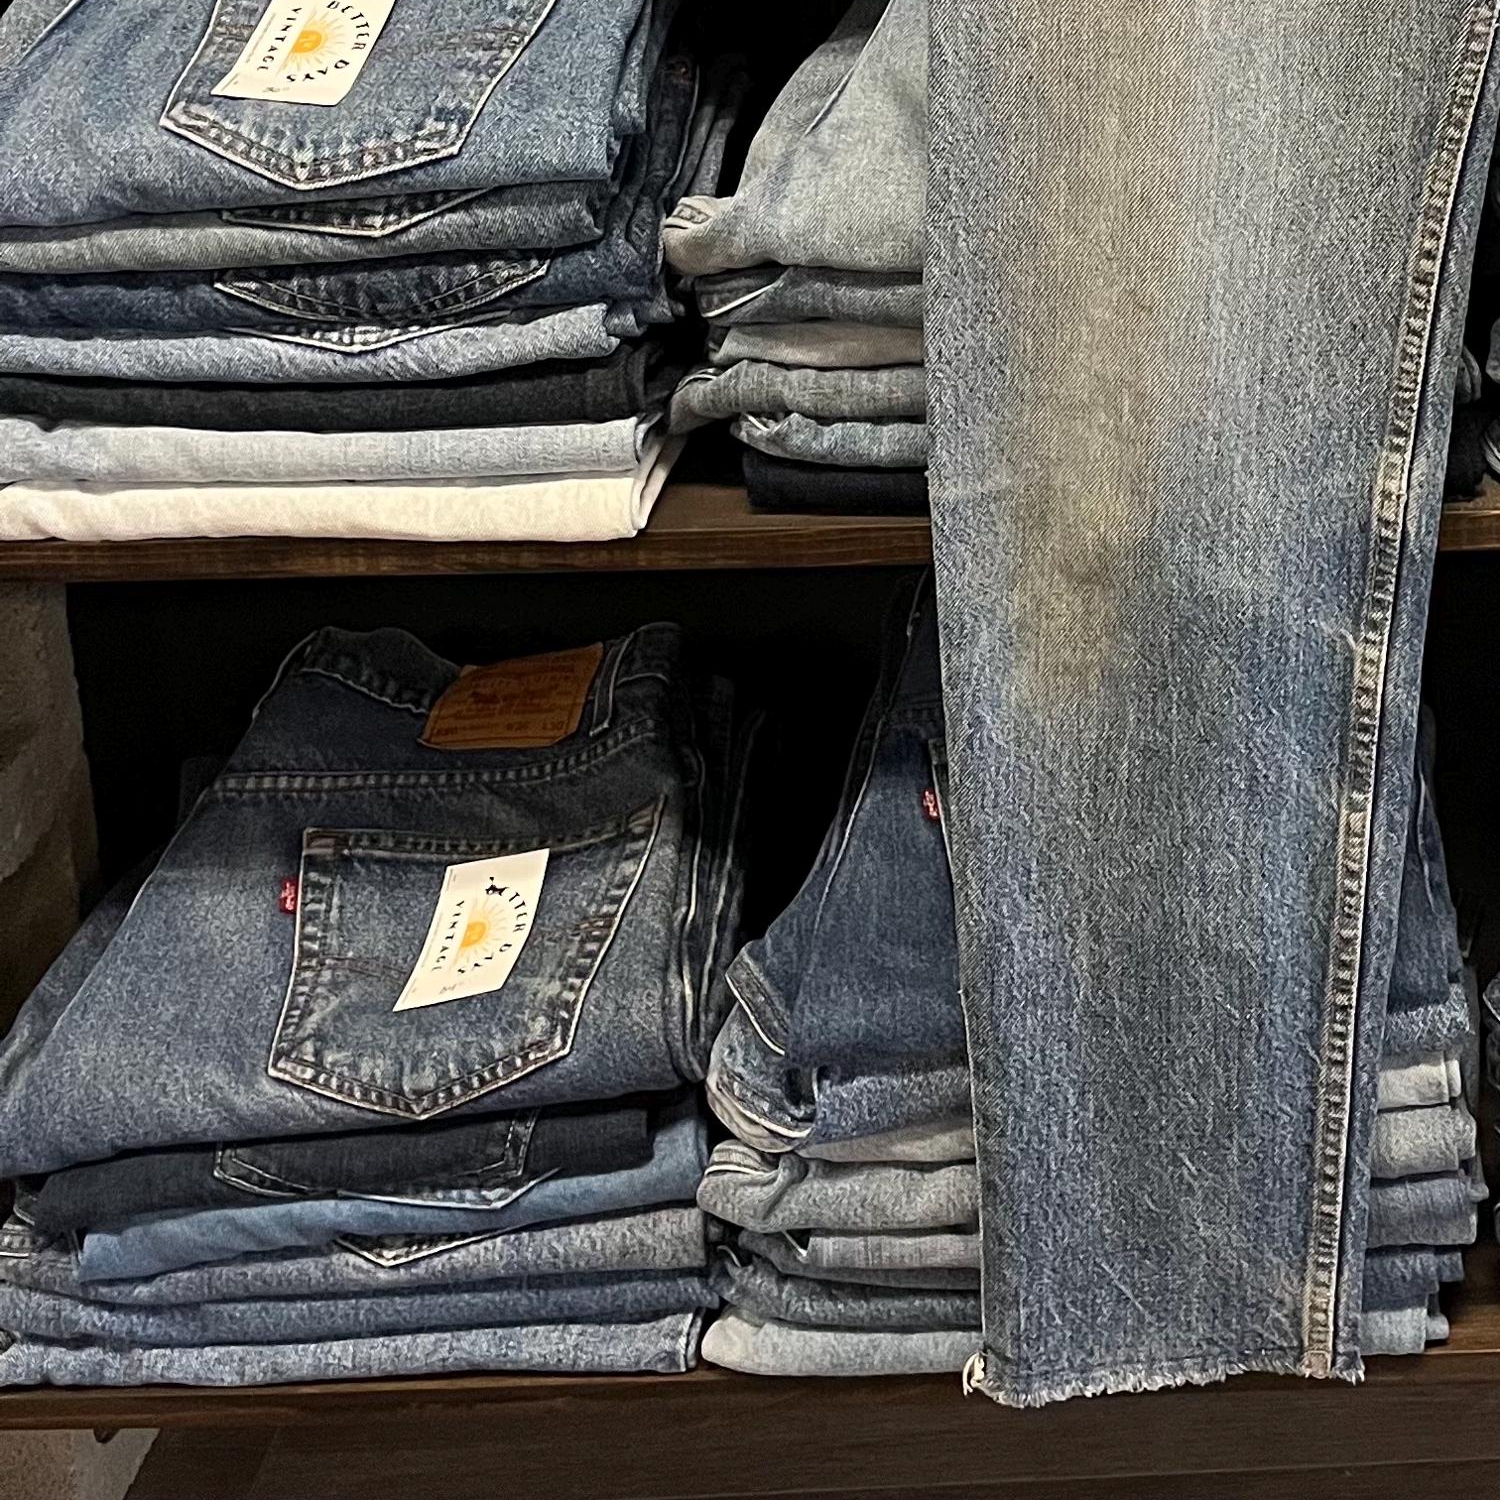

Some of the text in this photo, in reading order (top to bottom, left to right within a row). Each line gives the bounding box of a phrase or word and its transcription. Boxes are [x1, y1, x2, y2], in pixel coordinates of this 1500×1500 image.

[257, 7, 303, 72] VINTAGE
[326, 0, 370, 51] BETTER
[431, 899, 466, 972] VINTAGE
